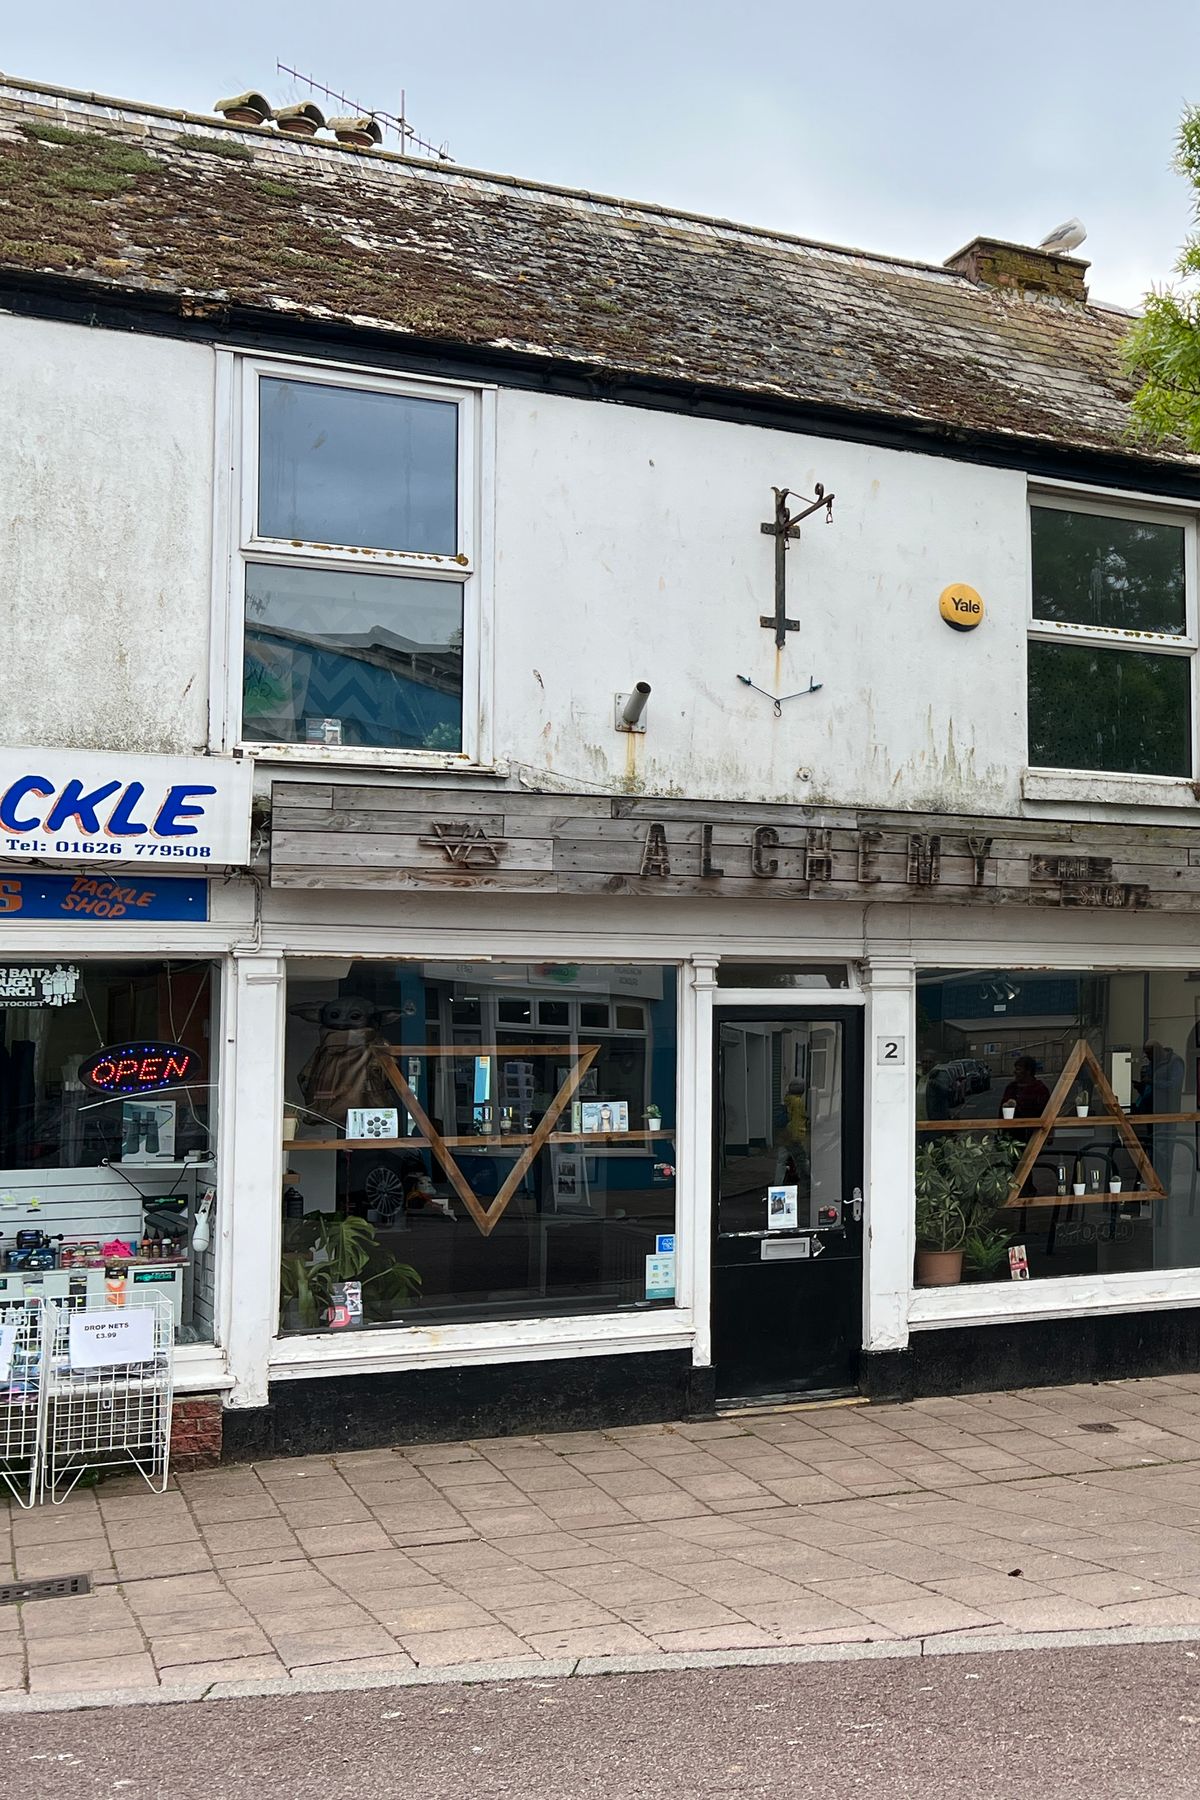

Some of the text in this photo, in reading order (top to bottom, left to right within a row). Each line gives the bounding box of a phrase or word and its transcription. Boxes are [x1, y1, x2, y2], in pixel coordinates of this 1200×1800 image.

[951, 597, 981, 613] Yale
[0, 775, 217, 838] CKLE
[6, 839, 211, 858] Tel: 01626 779508
[640, 821, 993, 885] ALCHEMY
[71, 876, 156, 907] TACKLE
[61, 894, 126, 918] SHOP
[9, 968, 44, 978] BAIT
[884, 1042, 898, 1058] 2
[92, 1056, 189, 1083] OPEN
[108, 1322, 129, 1330] NETS
